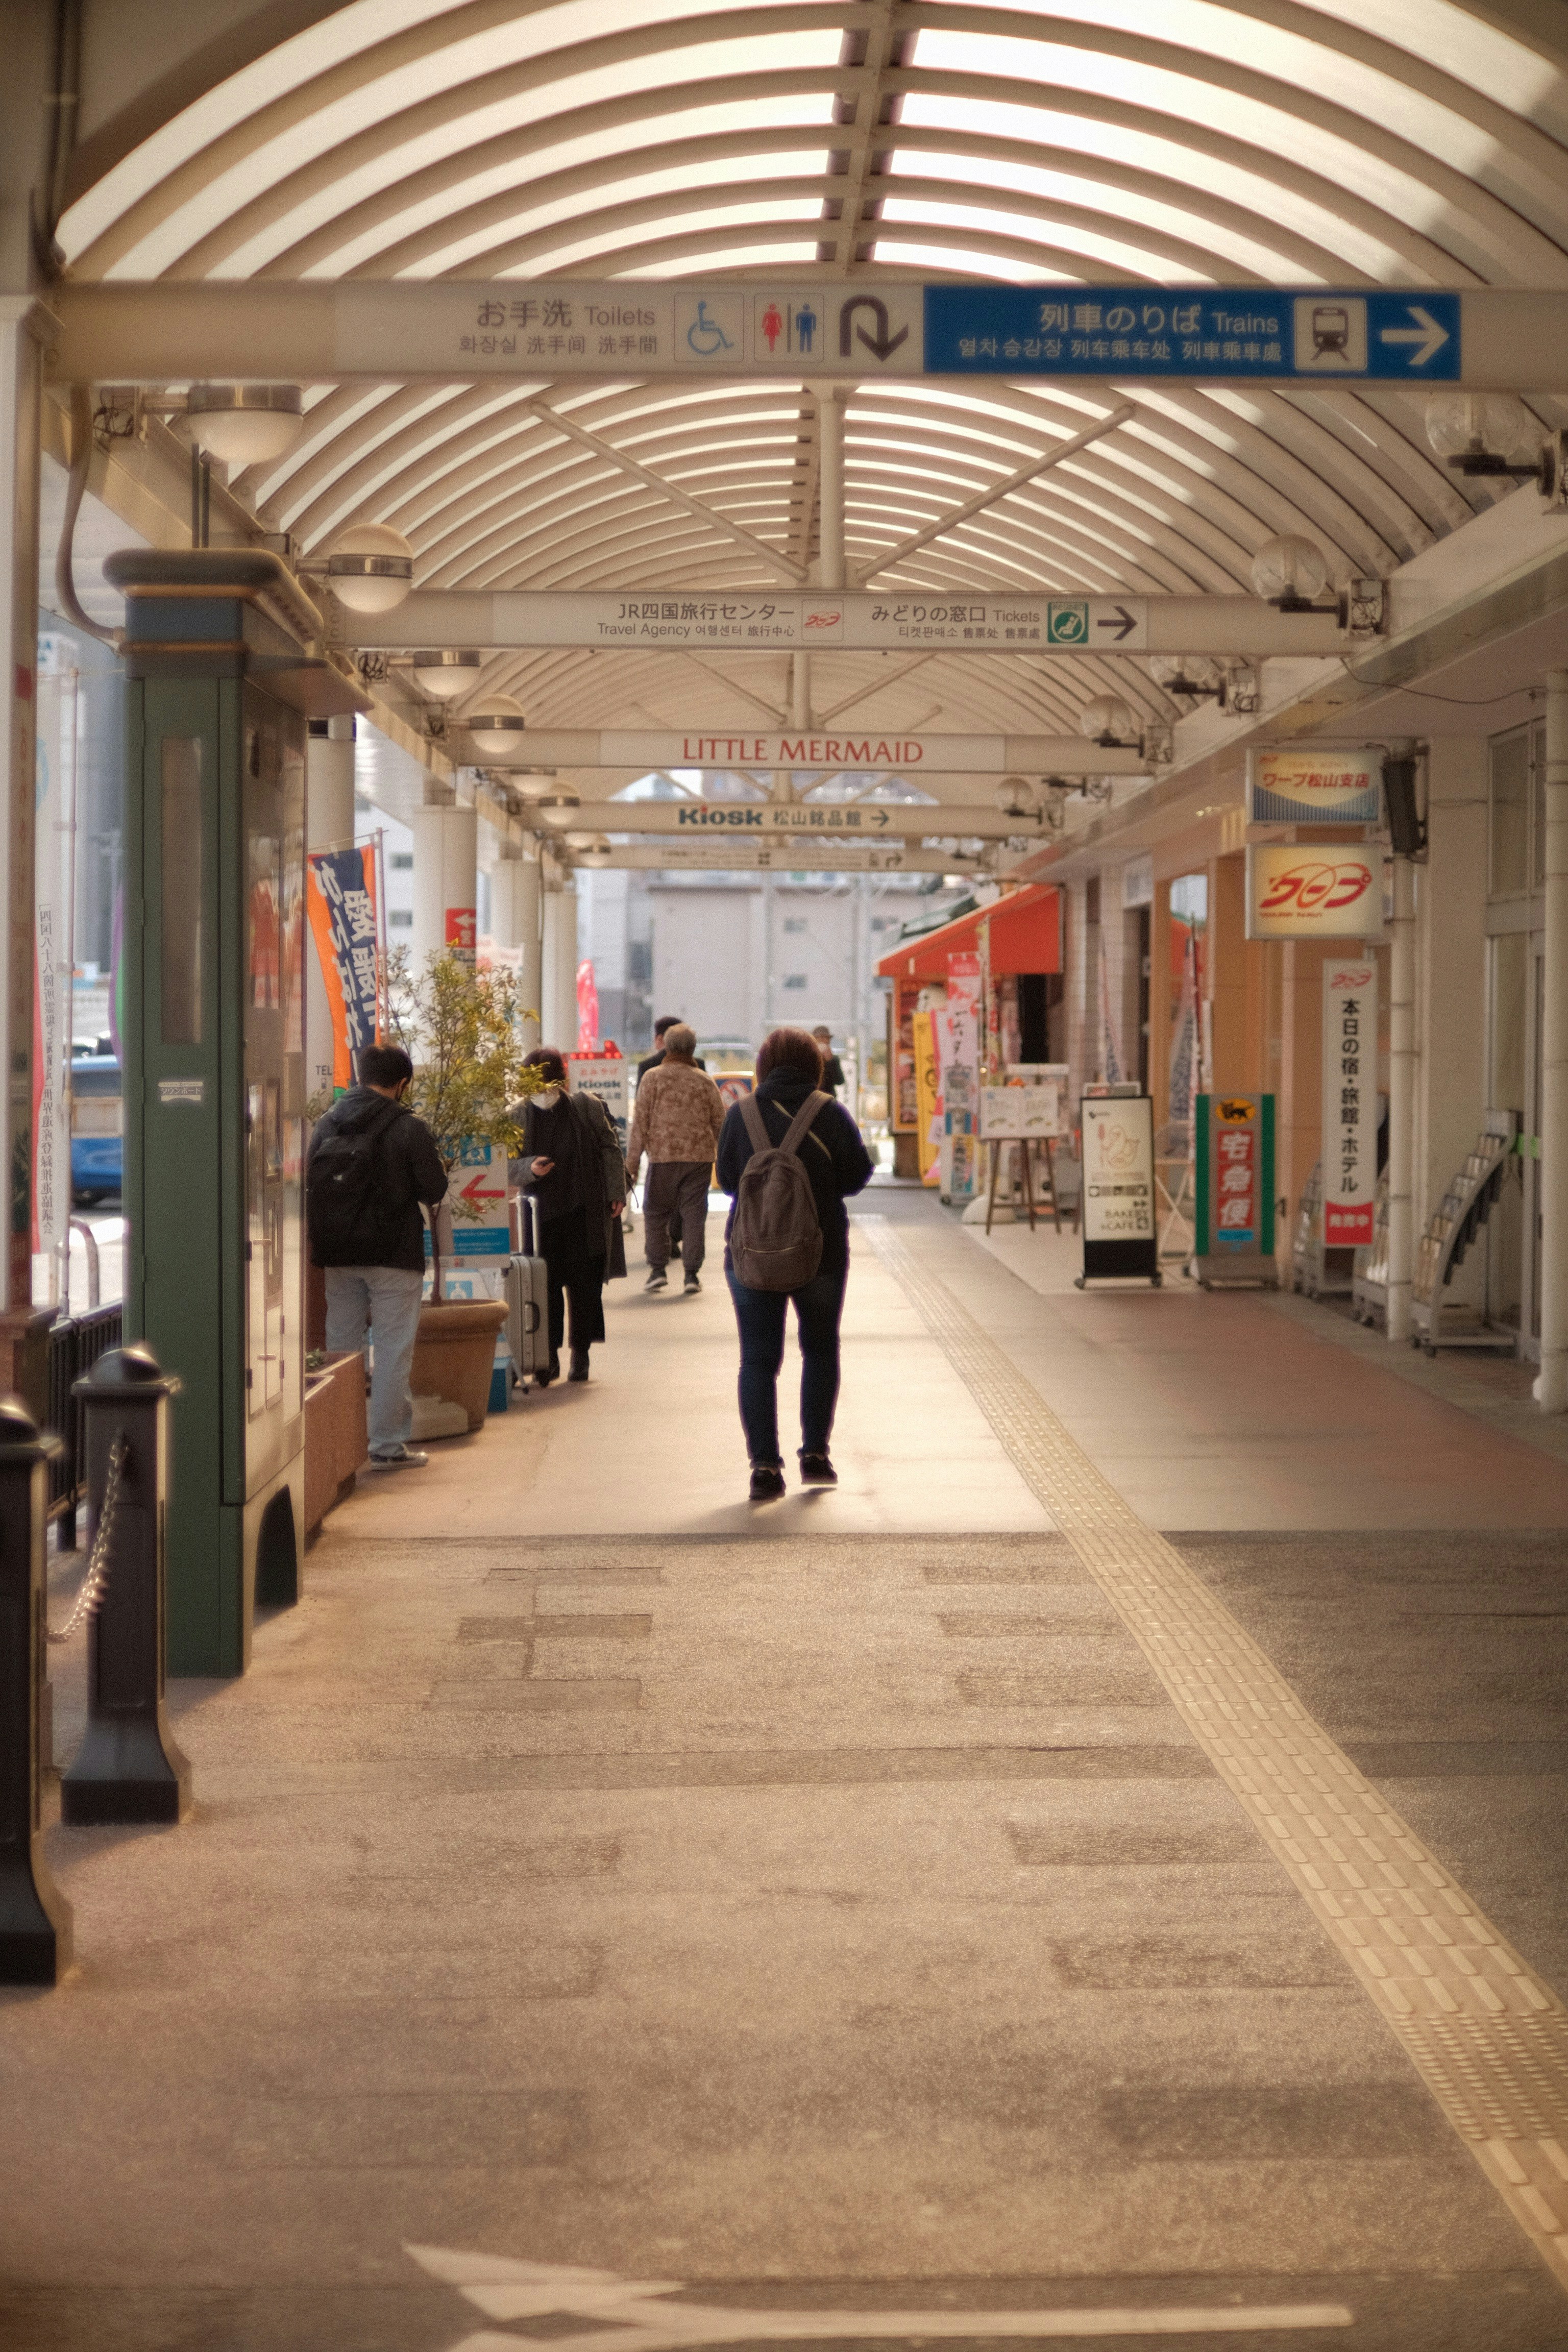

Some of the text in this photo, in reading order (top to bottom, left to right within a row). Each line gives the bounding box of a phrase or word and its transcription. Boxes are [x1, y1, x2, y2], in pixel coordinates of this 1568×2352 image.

[478, 300, 655, 328] お手洗 Toilets
[1041, 303, 1279, 334] 列車のりば Trains
[460, 334, 657, 355] 화장실 洗手间 洗手間
[619, 602, 1040, 623] JR四国旅行センター みどりの窓口 Tickets
[598, 622, 795, 638] Travel Agency 여행센터 旅行中心
[683, 738, 924, 763] LITTLE MERMAID
[678, 804, 763, 826] Kiosk
[315, 1065, 332, 1076] TEL
